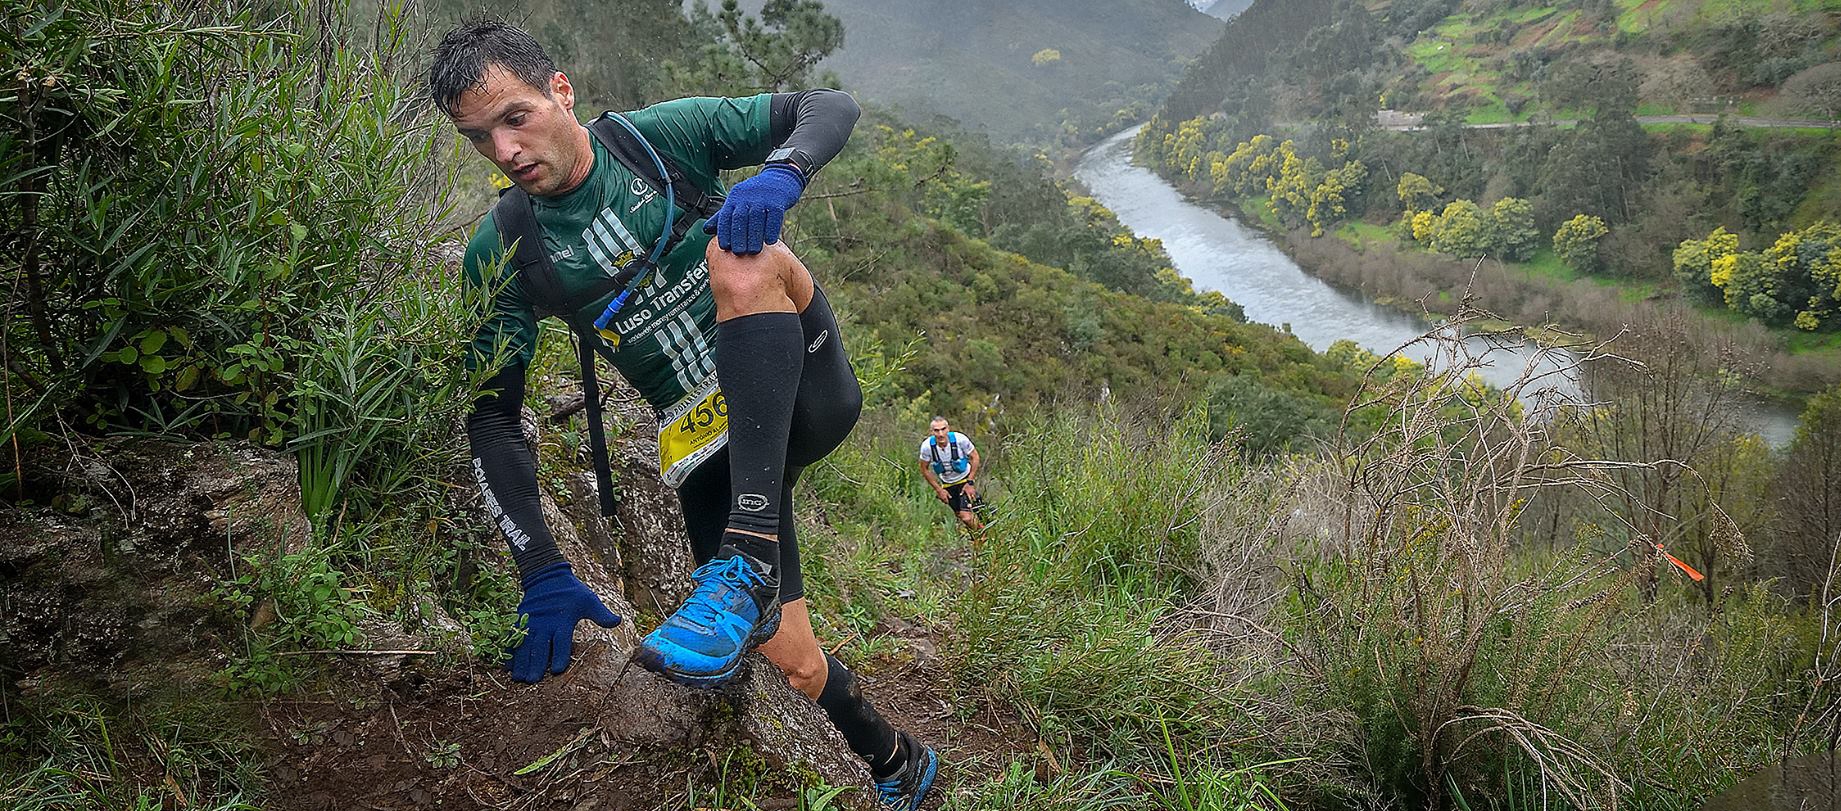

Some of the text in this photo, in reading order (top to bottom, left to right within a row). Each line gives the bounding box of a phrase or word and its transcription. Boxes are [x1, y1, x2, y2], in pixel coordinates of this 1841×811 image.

[615, 259, 709, 334] Luso Transfer
[674, 390, 701, 415] POIARES
[699, 372, 718, 390] TRAI
[680, 392, 728, 433] 456
[499, 514, 531, 551] TRAIL
